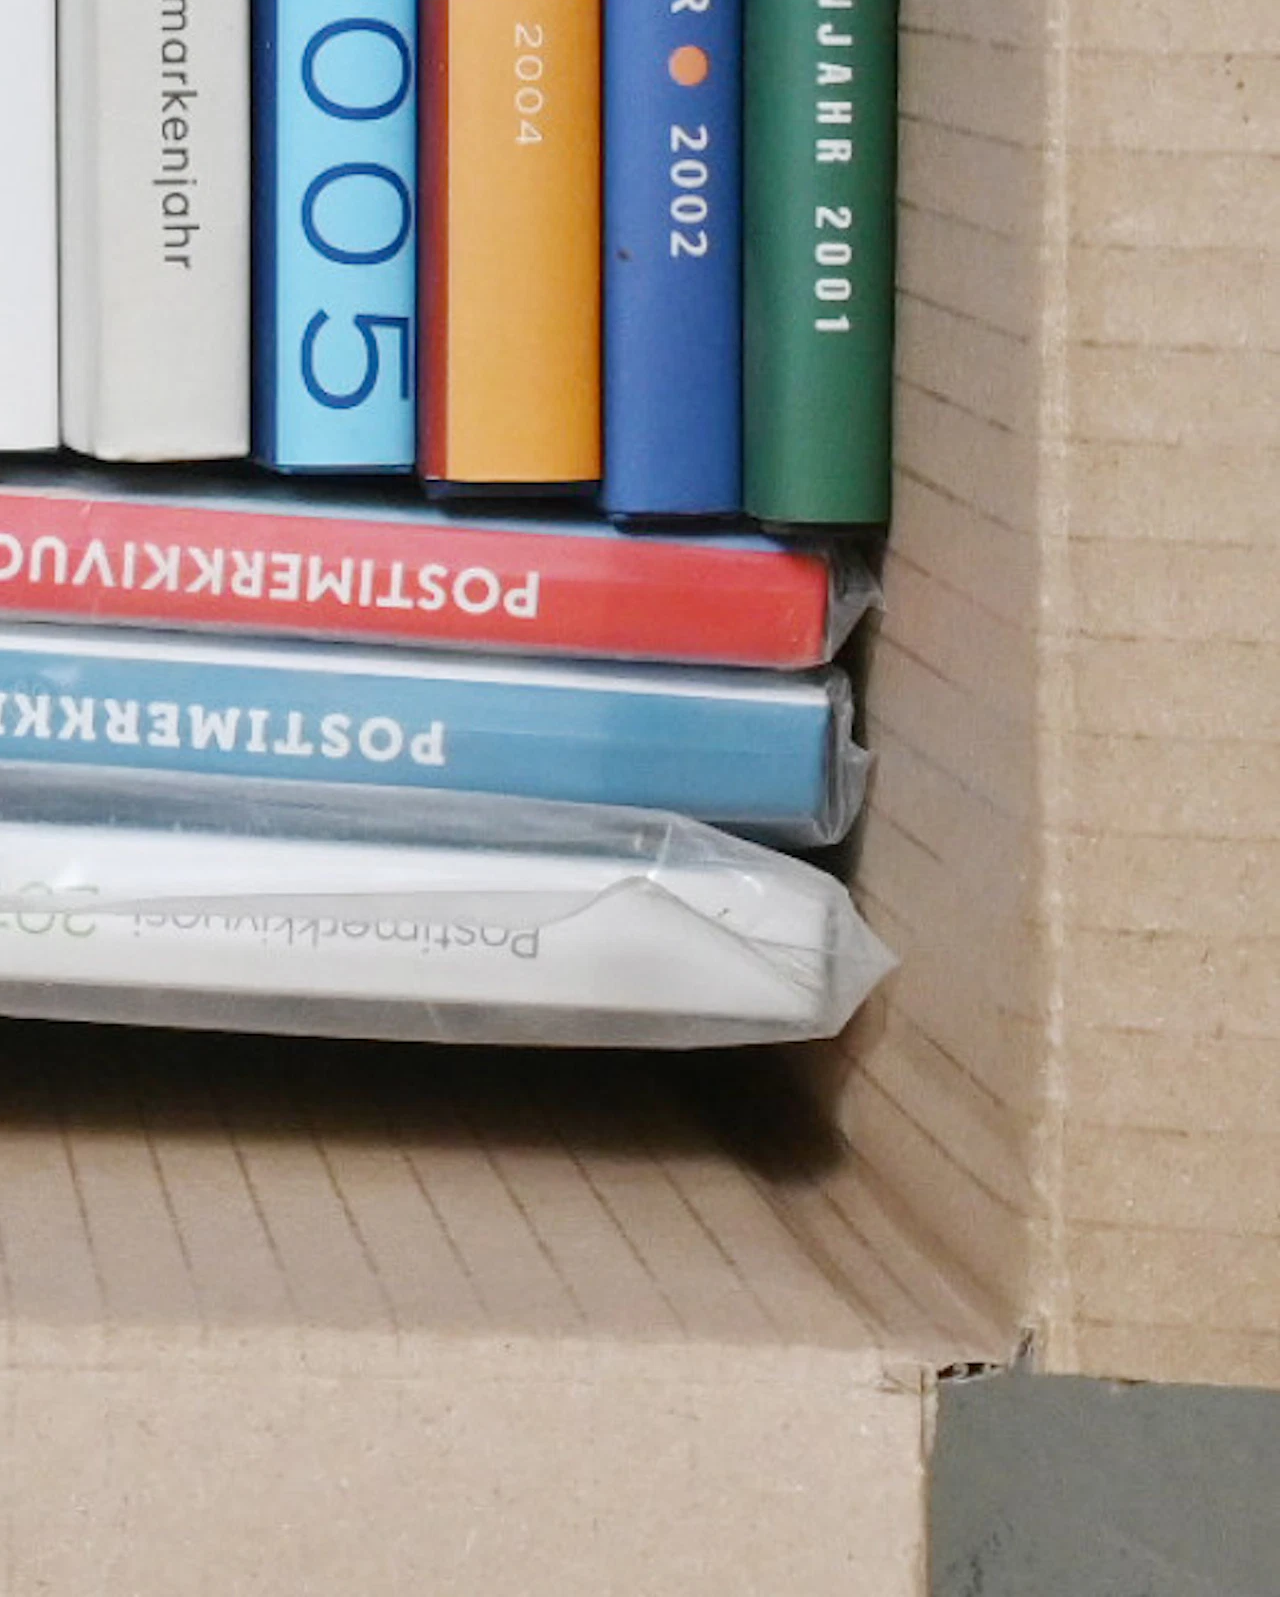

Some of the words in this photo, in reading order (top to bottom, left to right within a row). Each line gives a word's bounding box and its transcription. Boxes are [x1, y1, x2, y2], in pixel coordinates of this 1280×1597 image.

[515, 23, 543, 147] 2004
[669, 123, 708, 259] 2002
[813, 207, 851, 335] 2001
